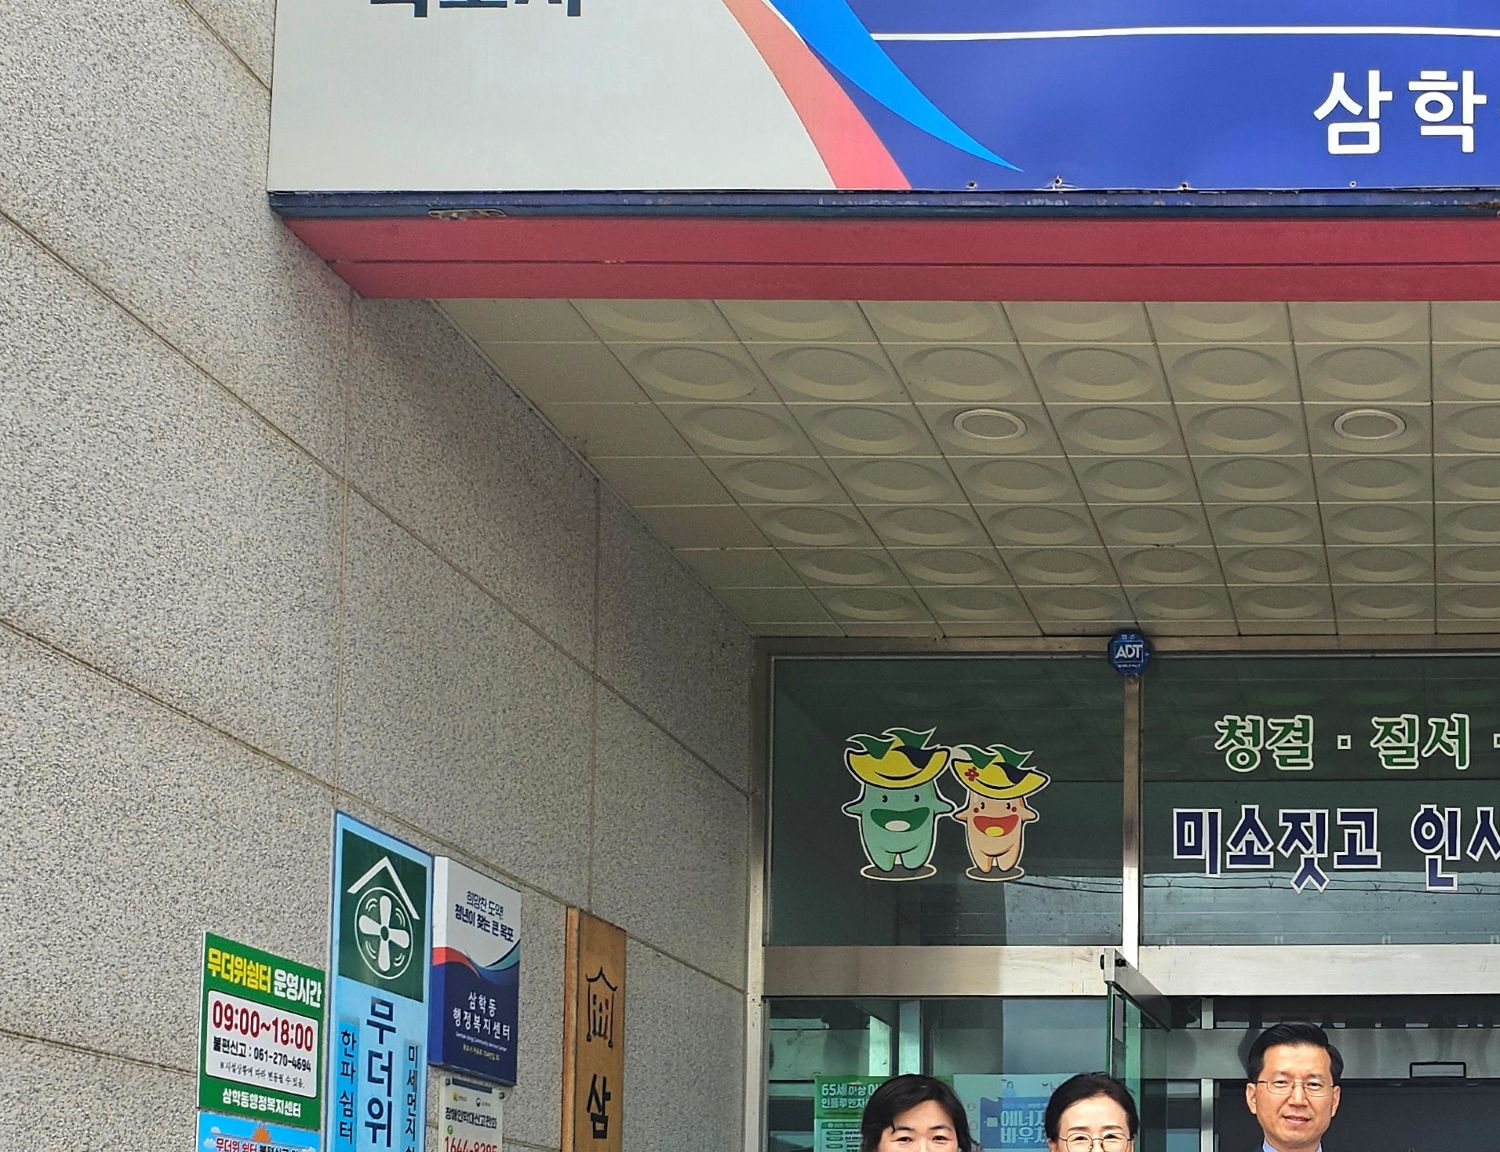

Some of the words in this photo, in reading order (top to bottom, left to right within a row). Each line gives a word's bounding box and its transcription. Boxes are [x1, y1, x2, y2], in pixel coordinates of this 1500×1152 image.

[1115, 644, 1143, 658] ADT
[1215, 714, 1314, 772] 청결
[1370, 713, 1470, 770] 질서
[1173, 804, 1381, 893] 미소짓고
[208, 947, 272, 993] 무더위쉼터
[274, 968, 322, 1008] 운영시간
[468, 991, 497, 1018] 삼학동
[213, 1000, 314, 1052] 09:00~18:00
[452, 1007, 511, 1041] 행정복지센터
[213, 1036, 247, 1058] 불편신고
[365, 996, 397, 1148] 무더위
[222, 1088, 301, 1117] 삼학동행정복지센터
[821, 1098, 868, 1109] 인플루엔자
